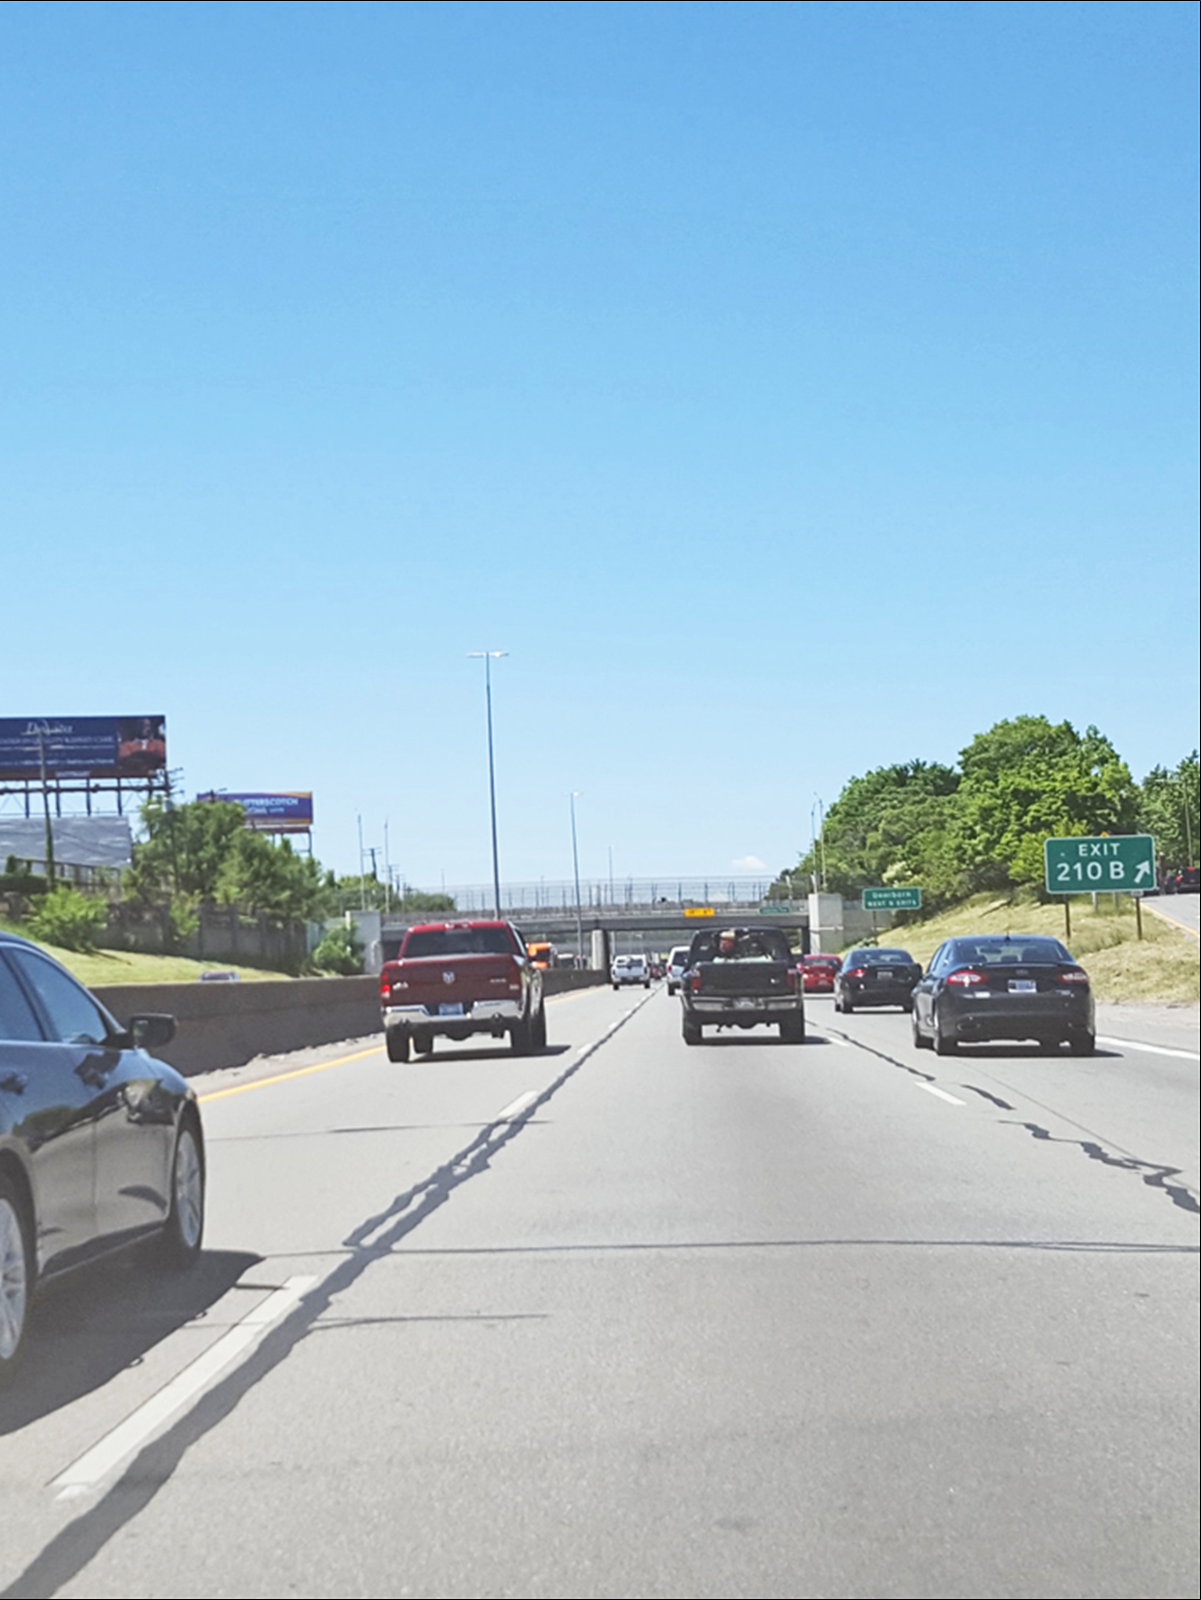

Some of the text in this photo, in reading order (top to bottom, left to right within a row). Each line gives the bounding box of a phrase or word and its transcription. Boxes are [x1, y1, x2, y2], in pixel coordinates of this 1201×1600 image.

[1078, 843, 1120, 857] EXIT
[1056, 861, 1125, 881] 210 B
